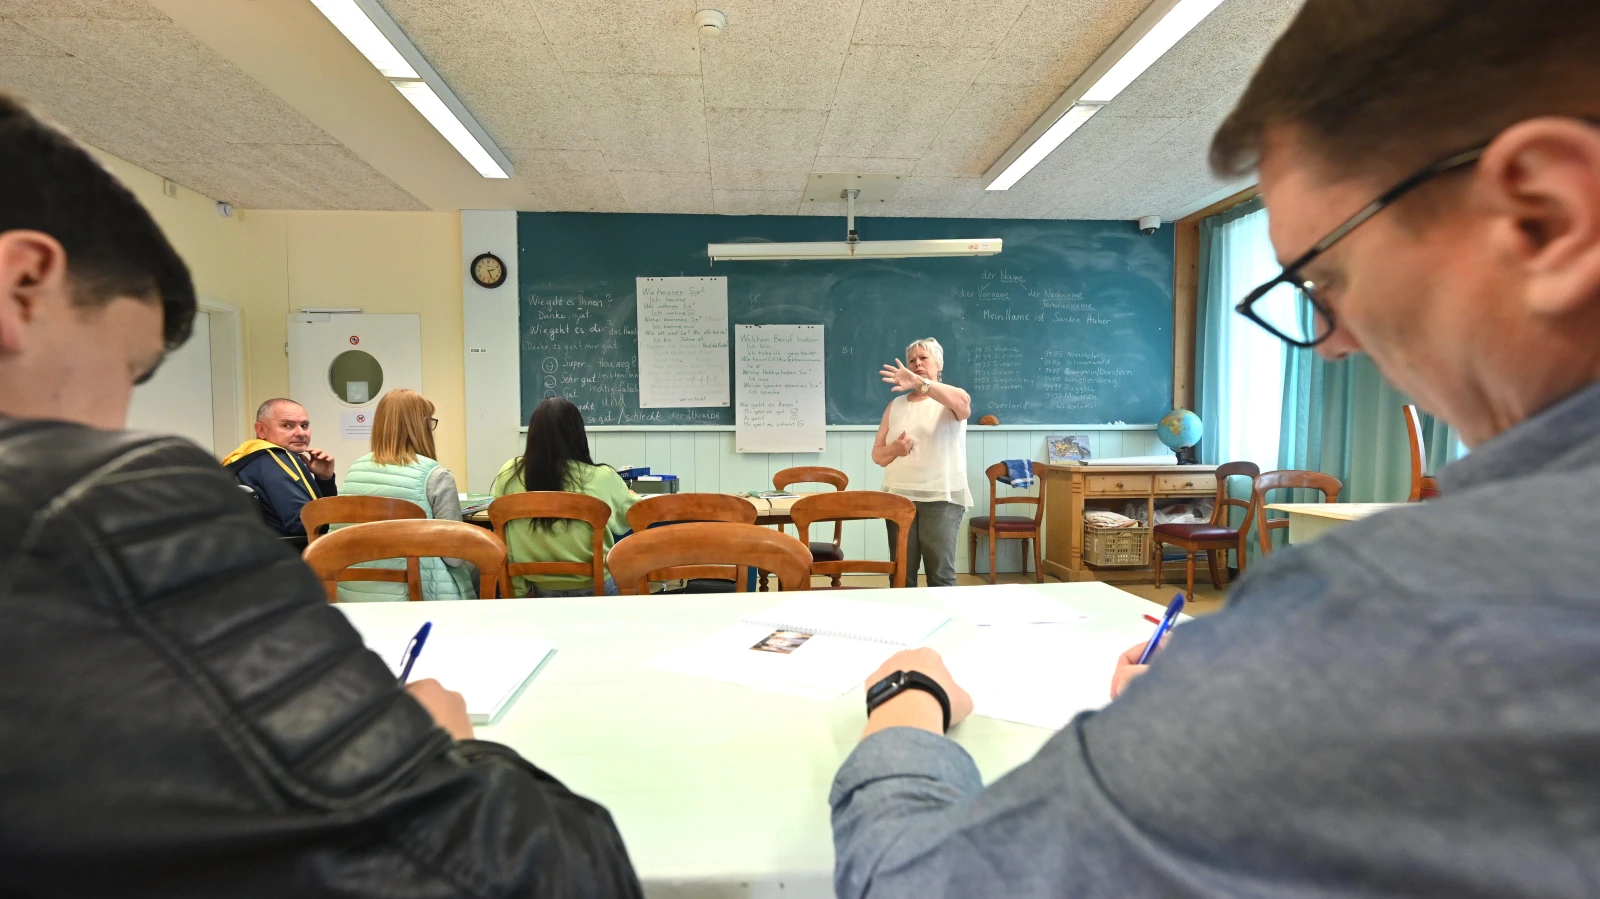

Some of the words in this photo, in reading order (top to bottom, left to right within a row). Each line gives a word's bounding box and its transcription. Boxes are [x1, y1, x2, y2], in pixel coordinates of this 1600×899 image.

[981, 269, 996, 280] der
[1000, 268, 1026, 283] Name
[959, 288, 975, 299] der
[1028, 289, 1040, 298] der
[528, 293, 544, 306] Wie
[545, 295, 564, 312] geht
[983, 309, 1004, 321] Mein
[1005, 308, 1029, 321] Name
[1034, 312, 1045, 323] ist
[1052, 312, 1080, 324] Sandra
[530, 322, 549, 335] Wie
[549, 322, 569, 341] geht
[574, 325, 585, 334] es
[773, 333, 794, 343] Beruf
